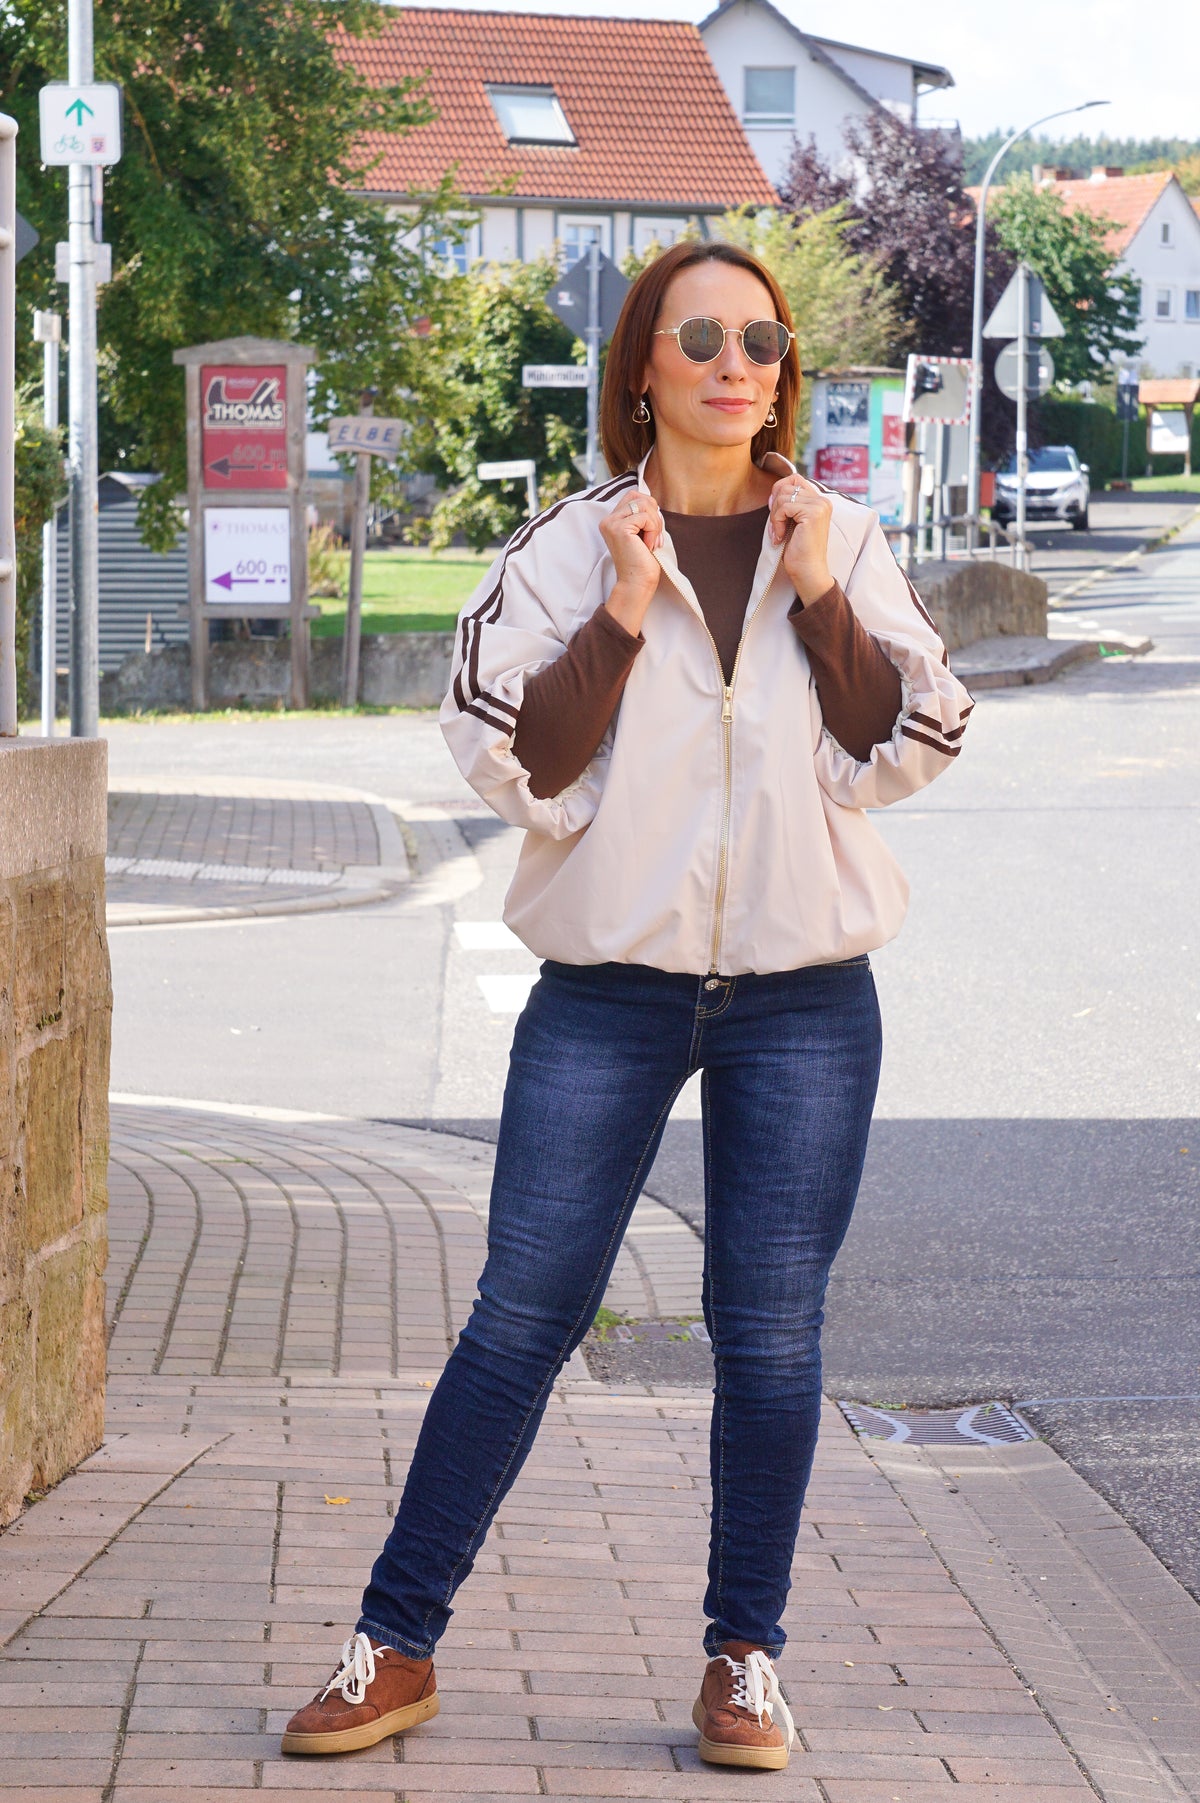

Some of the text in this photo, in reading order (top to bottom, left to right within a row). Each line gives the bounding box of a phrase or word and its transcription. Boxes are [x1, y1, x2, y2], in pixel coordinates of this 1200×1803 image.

[213, 403, 283, 420] THOMAS
[337, 424, 395, 442] ELBE
[236, 559, 287, 575] 600 m
